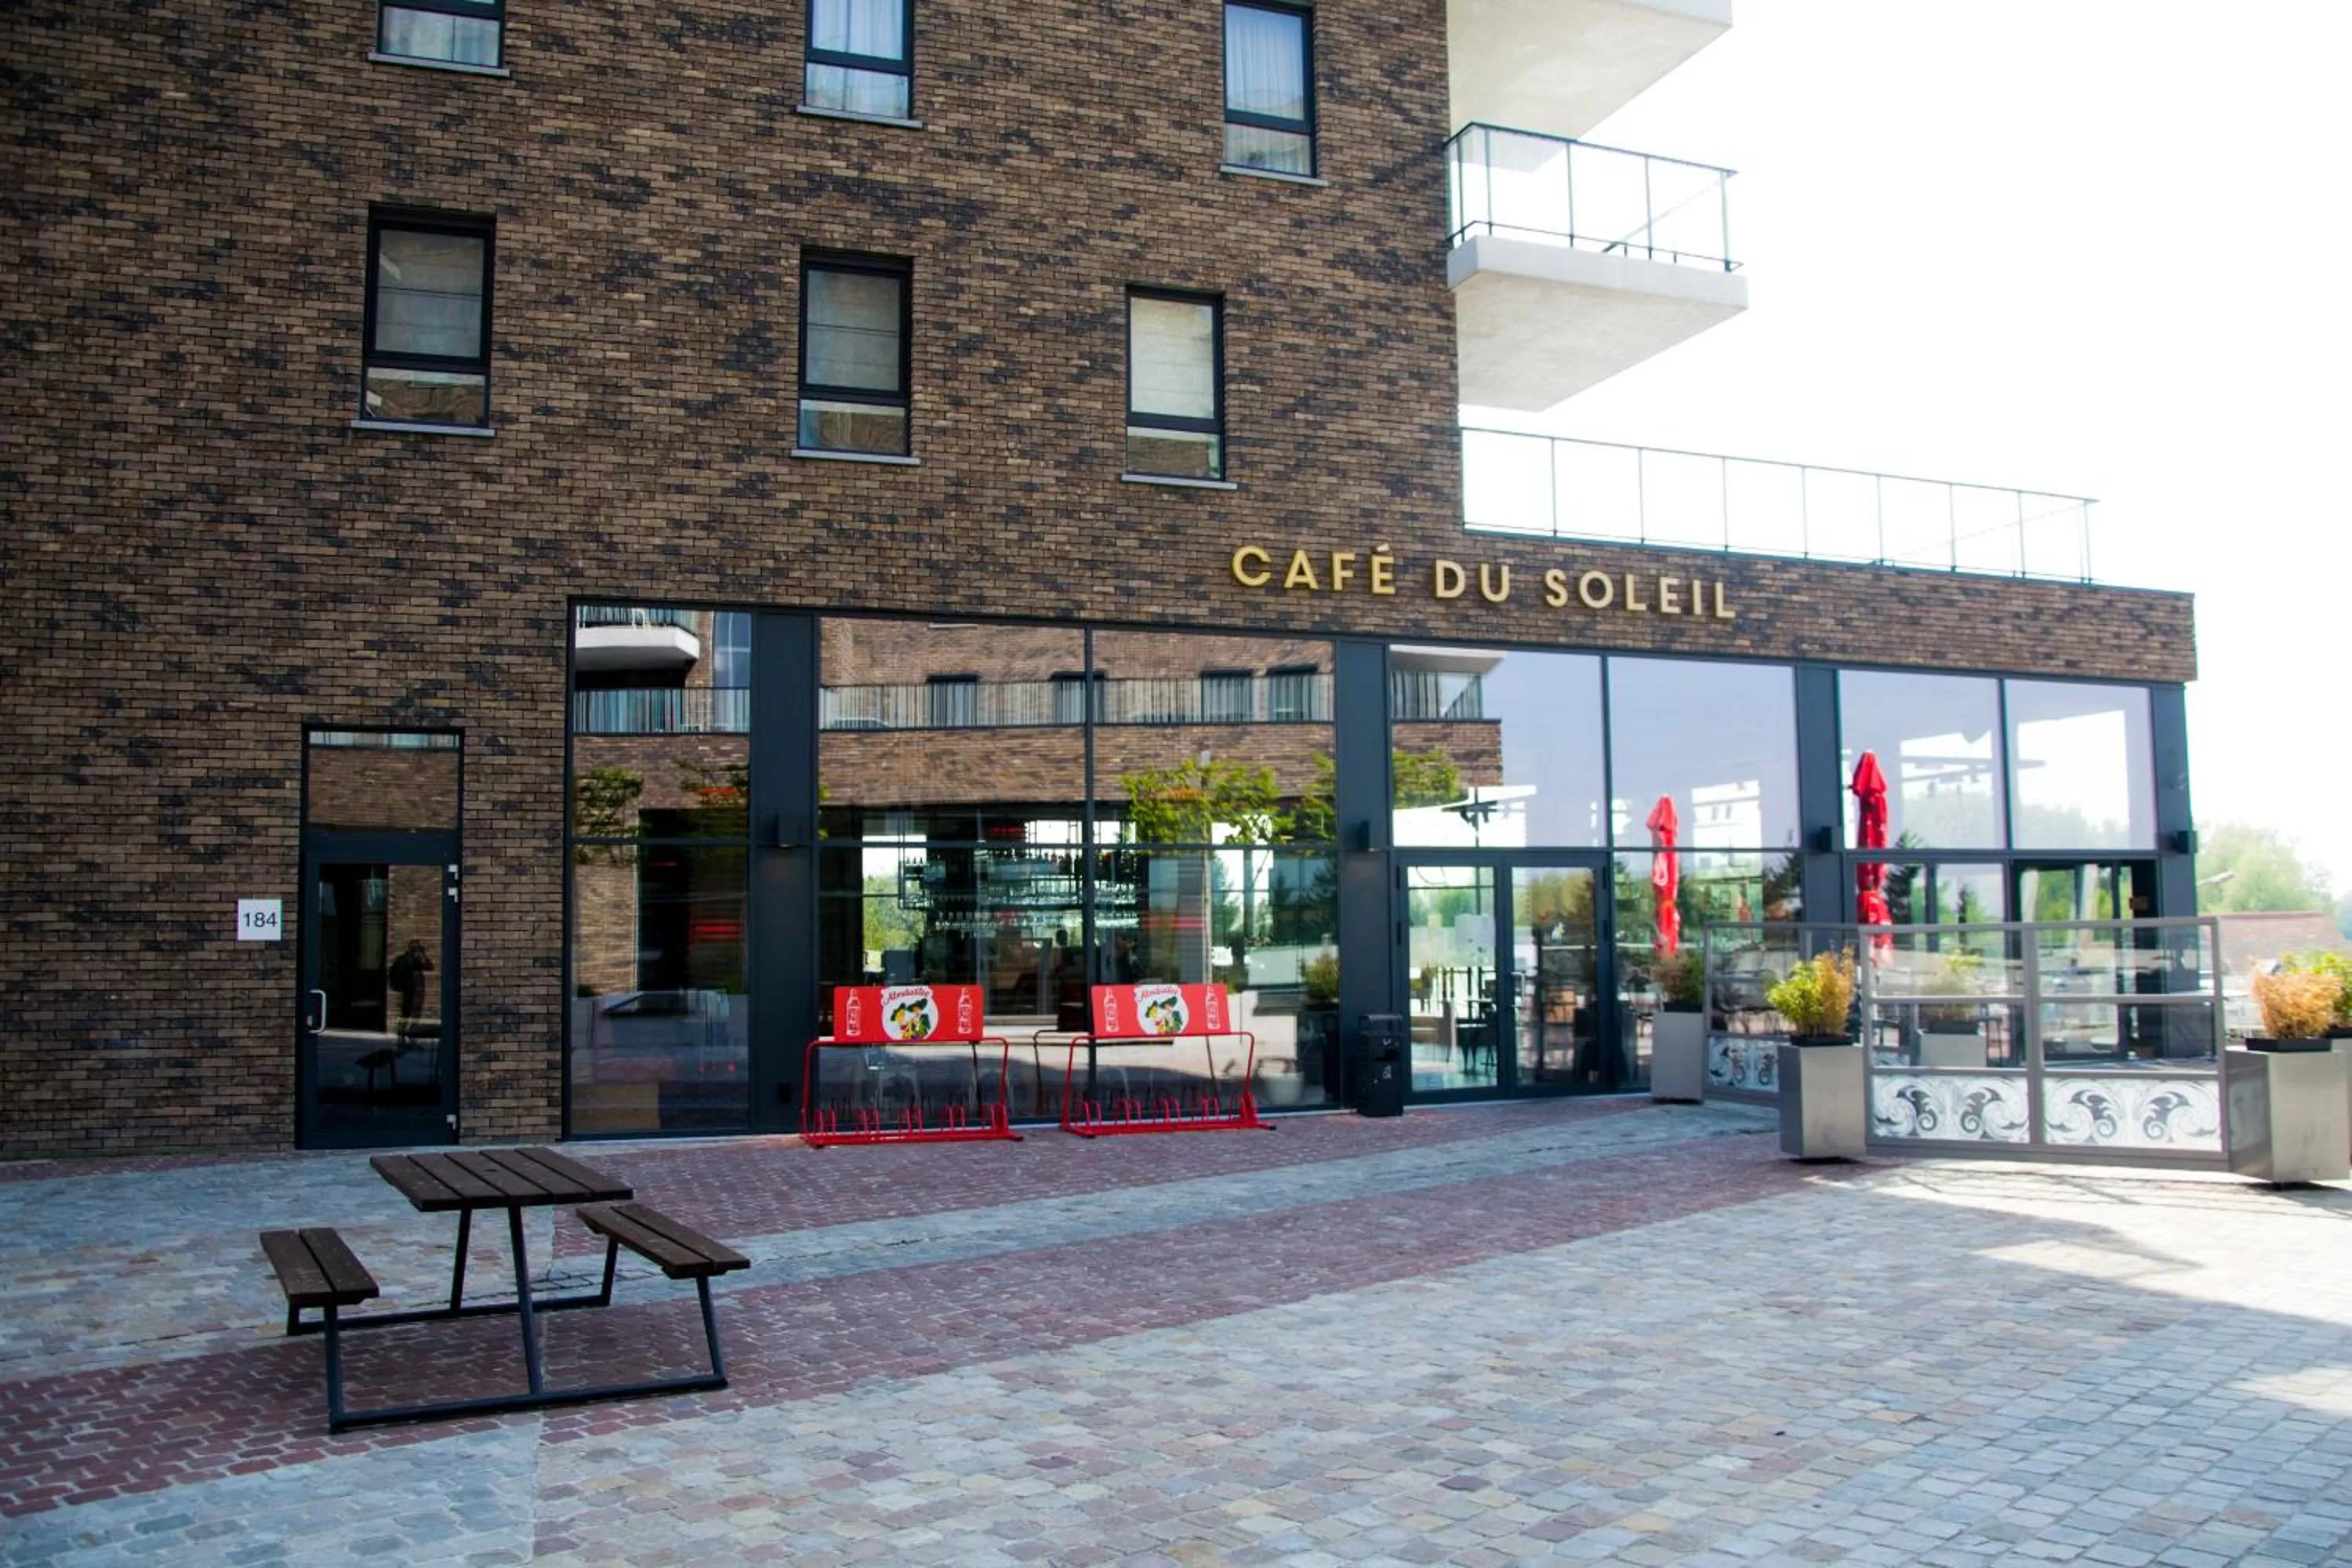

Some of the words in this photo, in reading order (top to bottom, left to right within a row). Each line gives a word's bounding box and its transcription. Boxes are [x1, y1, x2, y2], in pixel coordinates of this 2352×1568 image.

[1231, 543, 1397, 595] CAFÉ
[1434, 559, 1511, 604] DU
[1544, 568, 1736, 619] SOLEIL
[243, 912, 278, 928] 184
